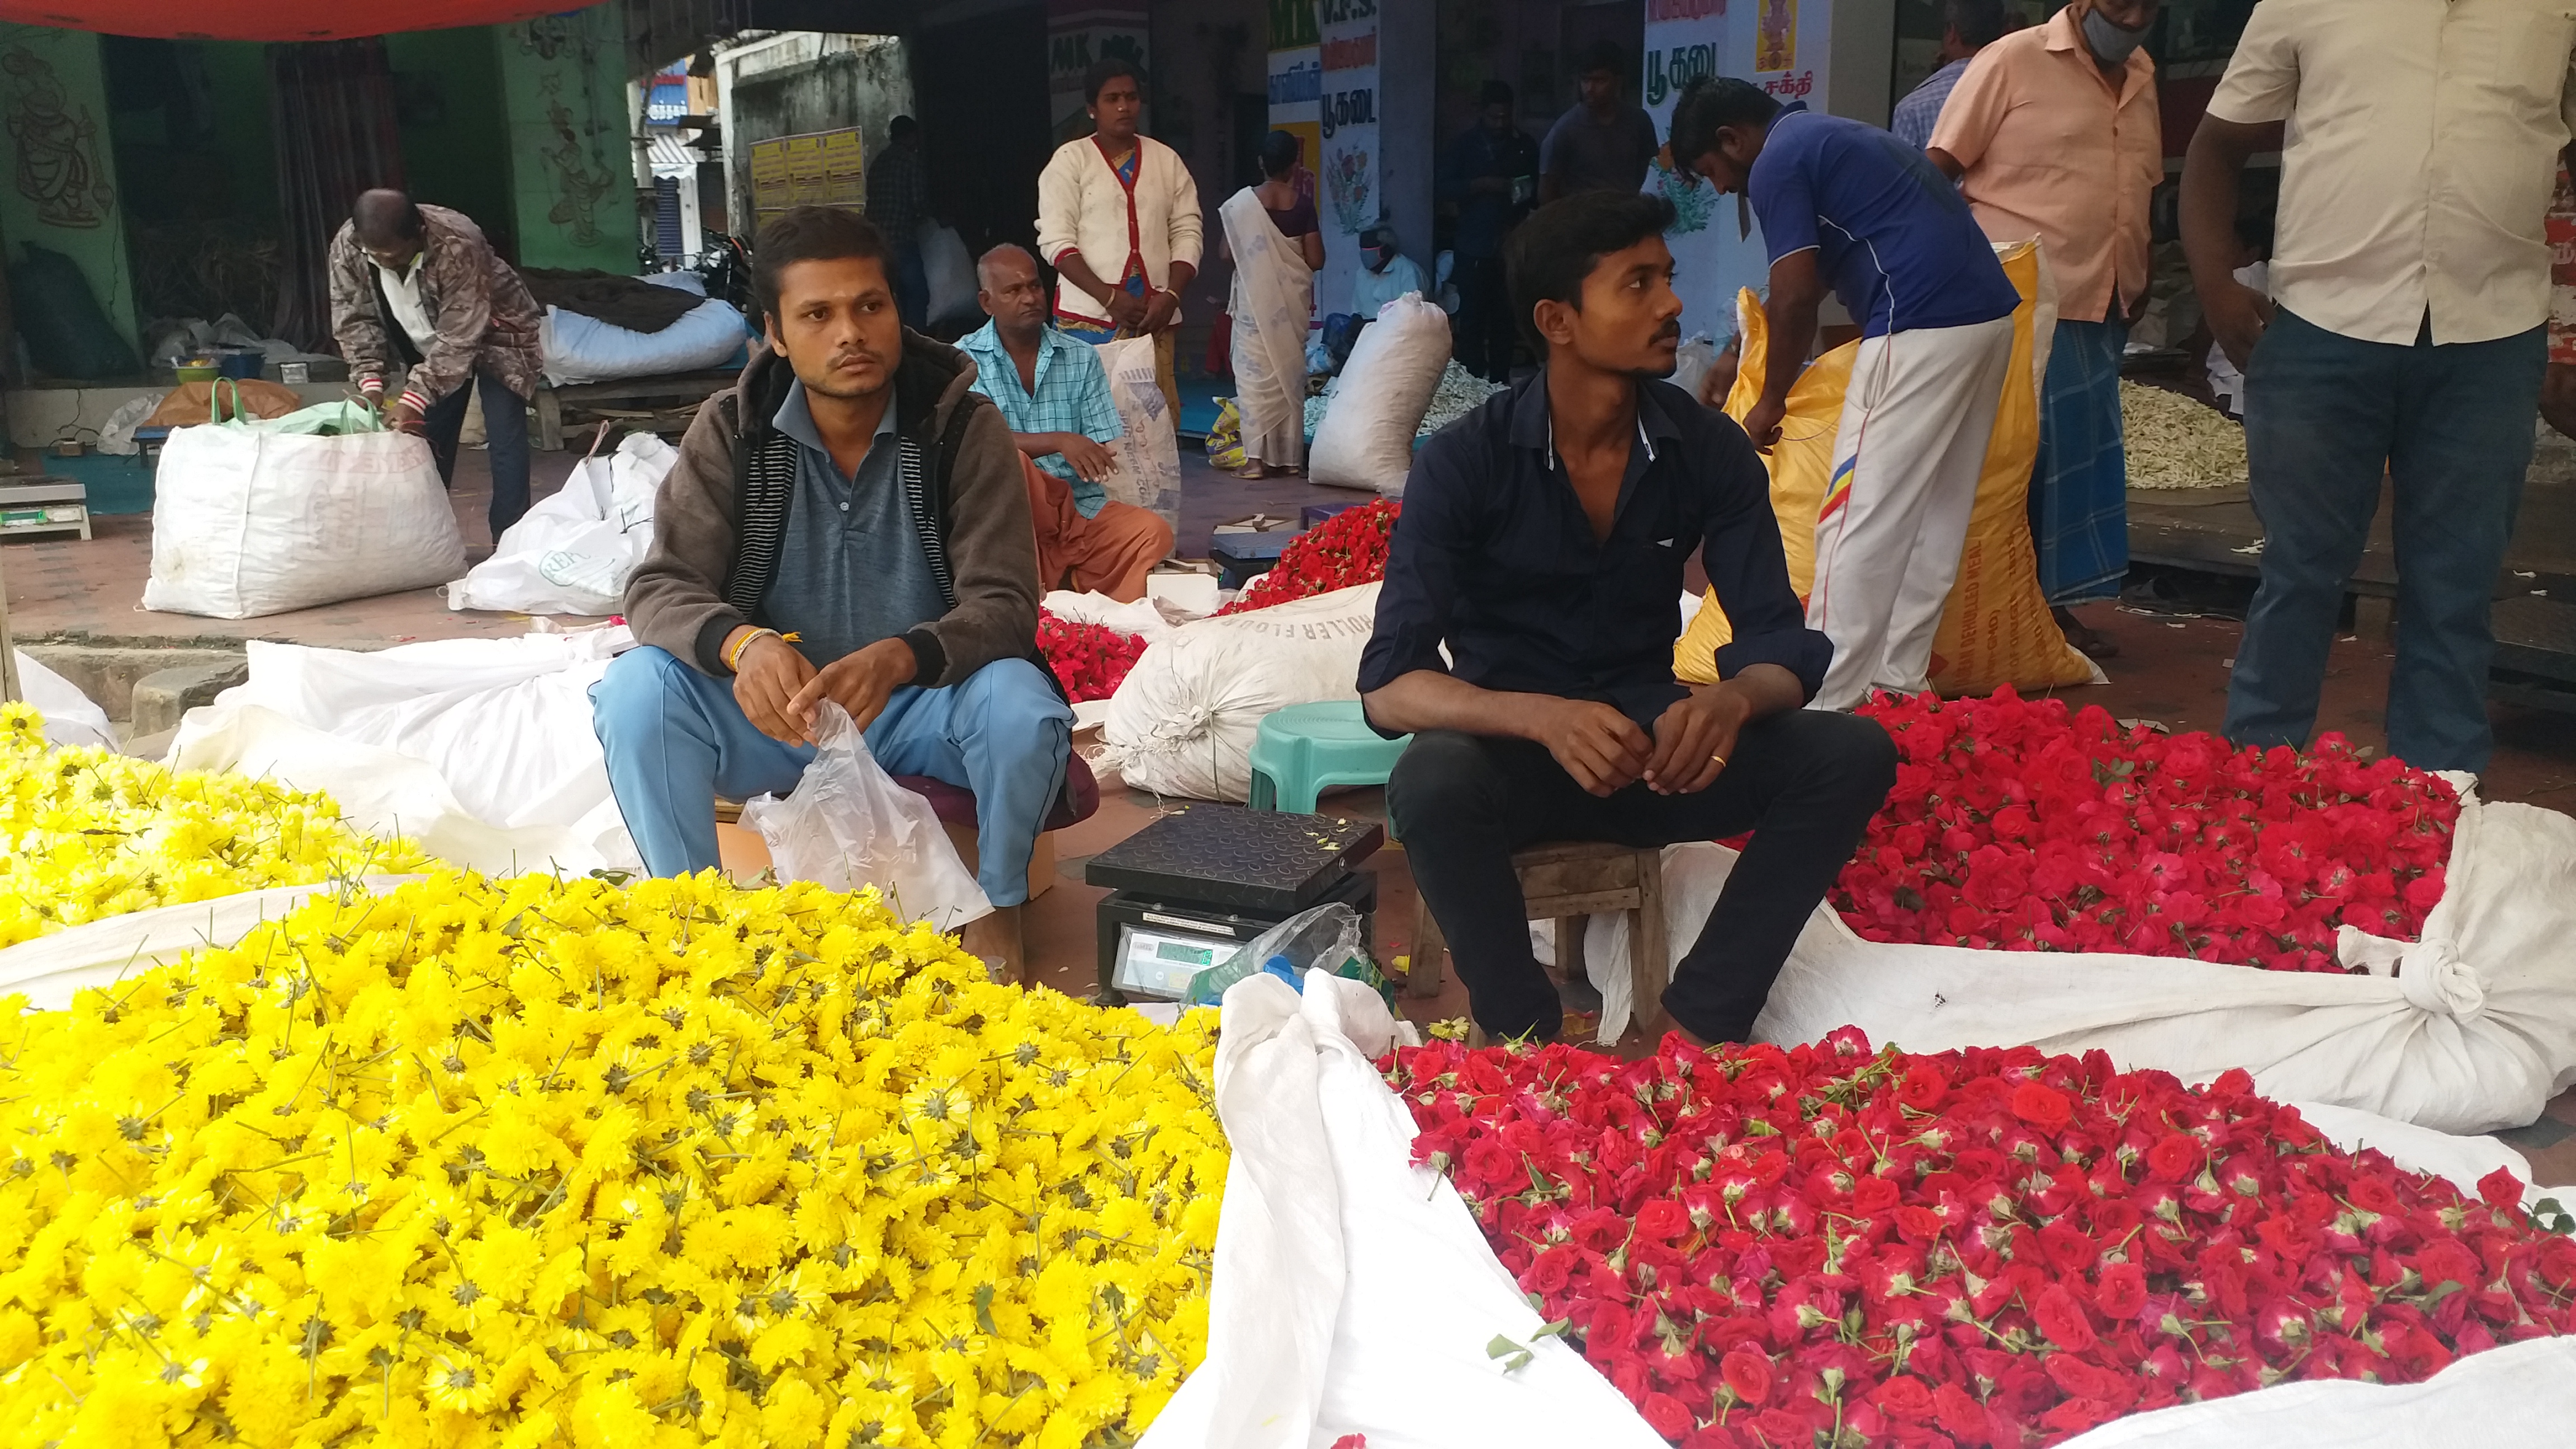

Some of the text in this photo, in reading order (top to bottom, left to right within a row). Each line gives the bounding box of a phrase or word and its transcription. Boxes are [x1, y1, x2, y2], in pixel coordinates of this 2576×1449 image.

[1967, 541, 1982, 580] MEAL
[1221, 614, 1372, 640] ROLLER FLOUR
[1961, 582, 1980, 648] DEHULLED
